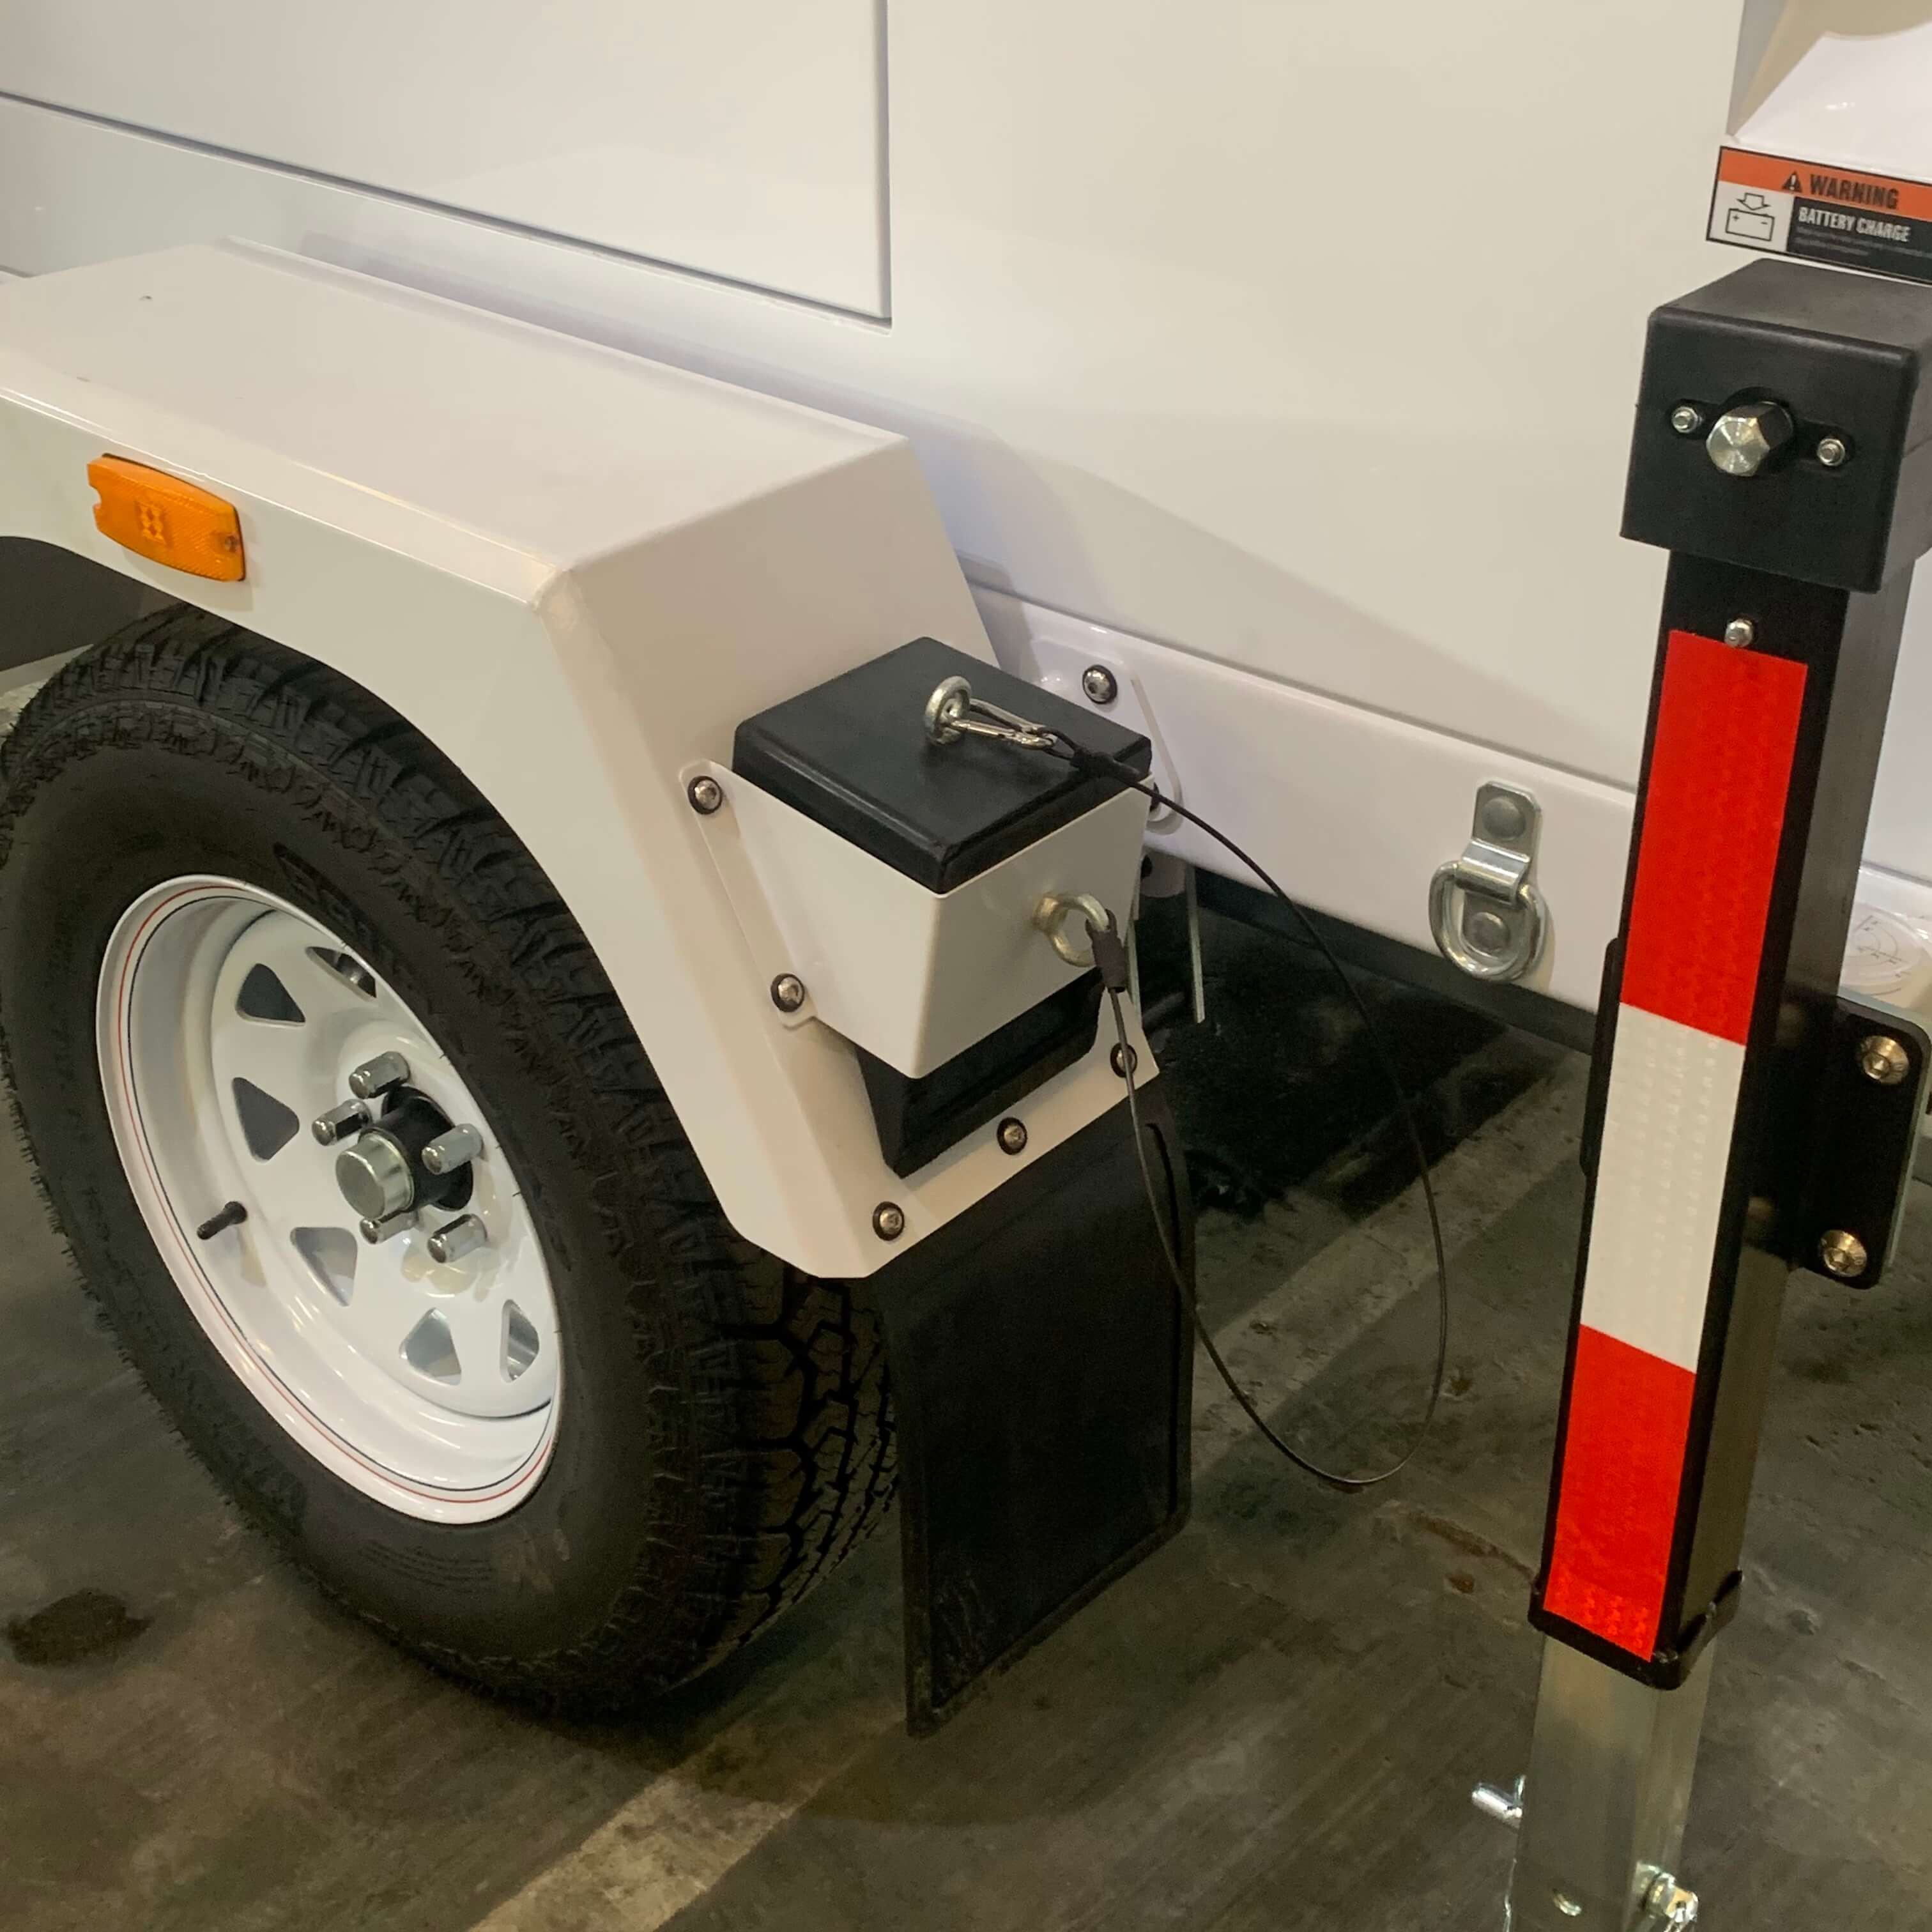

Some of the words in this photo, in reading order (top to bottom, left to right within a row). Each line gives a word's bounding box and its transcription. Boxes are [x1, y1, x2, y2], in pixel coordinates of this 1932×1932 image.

[1810, 174, 1899, 209] WARNING
[1798, 206, 1855, 231] BATTERY
[1856, 217, 1912, 242] CHARGE
